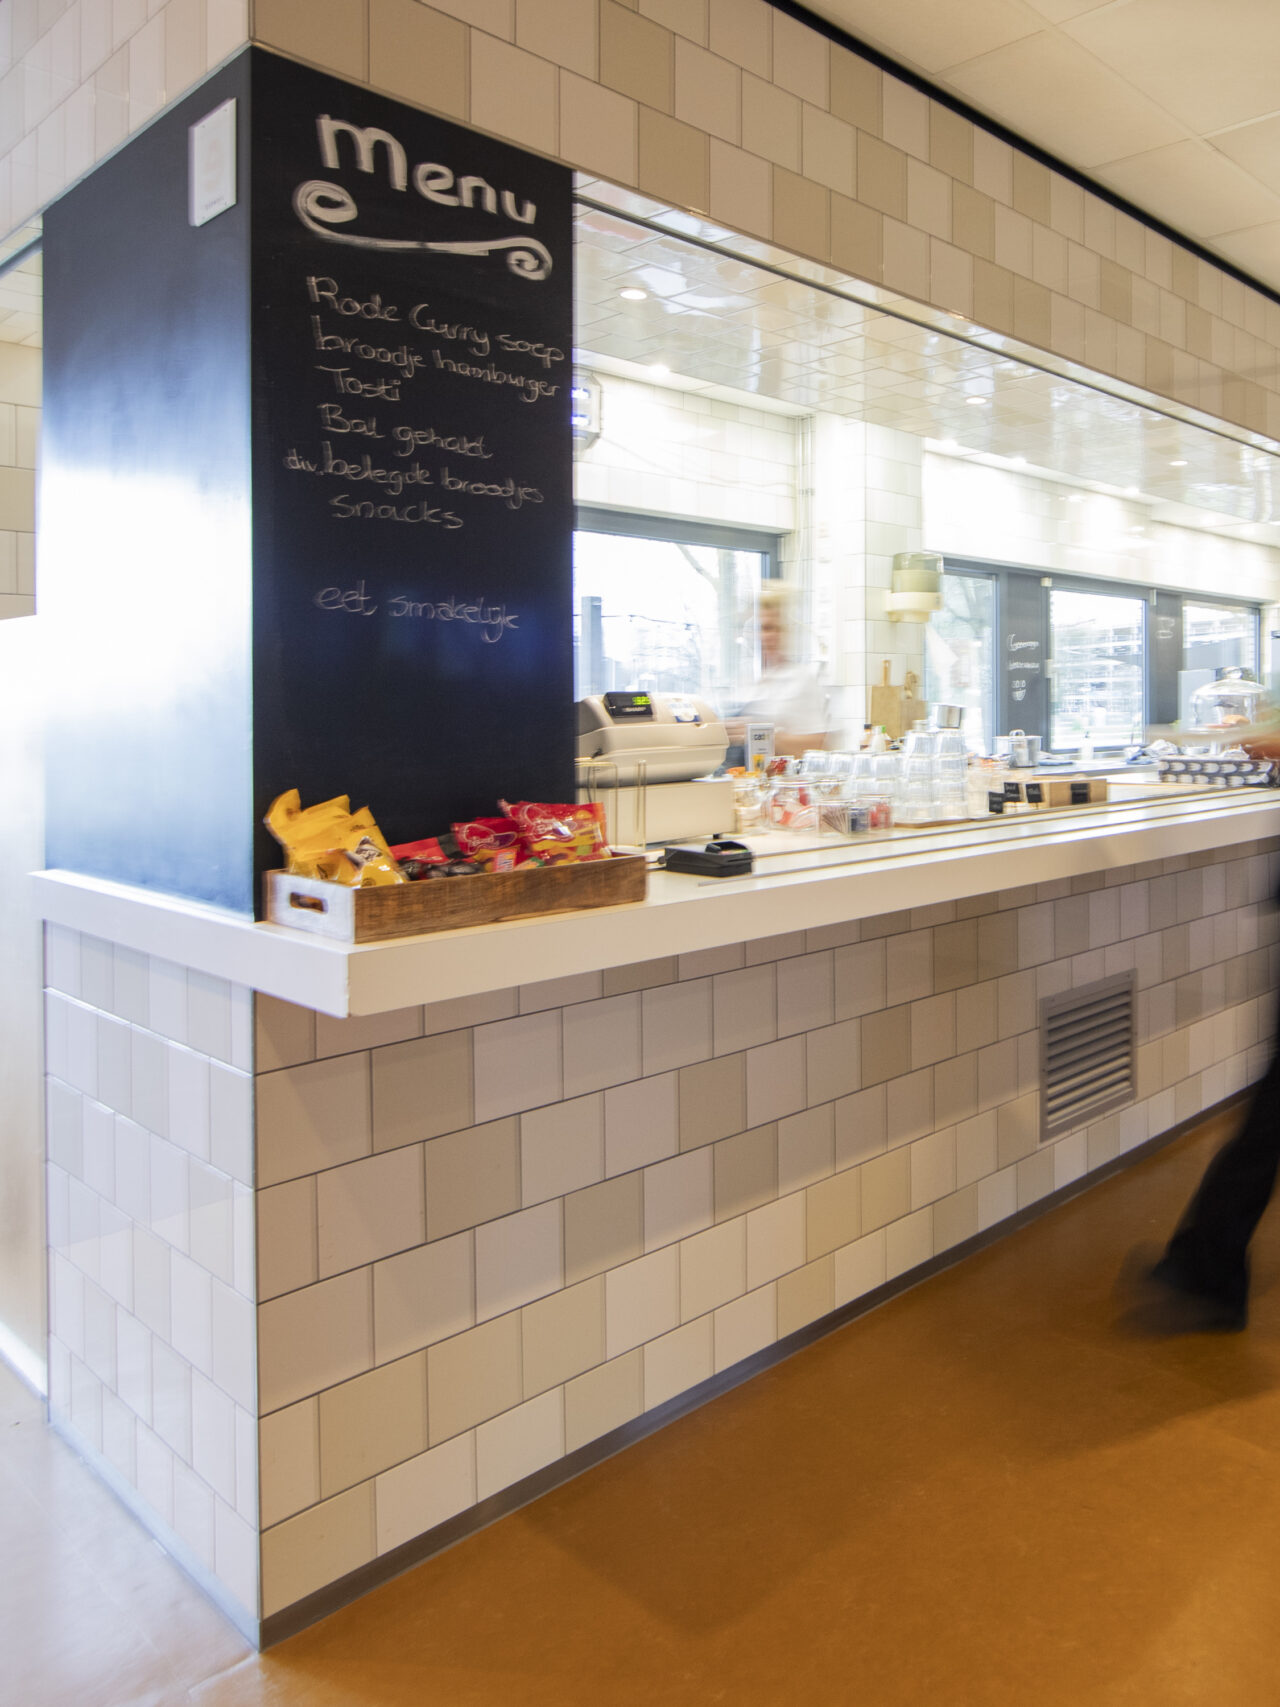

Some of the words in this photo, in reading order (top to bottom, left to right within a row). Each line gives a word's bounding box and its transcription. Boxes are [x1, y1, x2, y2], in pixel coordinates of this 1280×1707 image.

[316, 113, 537, 225] Menu
[306, 275, 400, 322] Rode
[311, 315, 427, 378] broodje
[432, 349, 560, 403] hamburger
[313, 365, 401, 401] Tosti
[316, 403, 386, 434] Bal
[321, 440, 435, 495] belegde
[440, 466, 545, 510] broodjes
